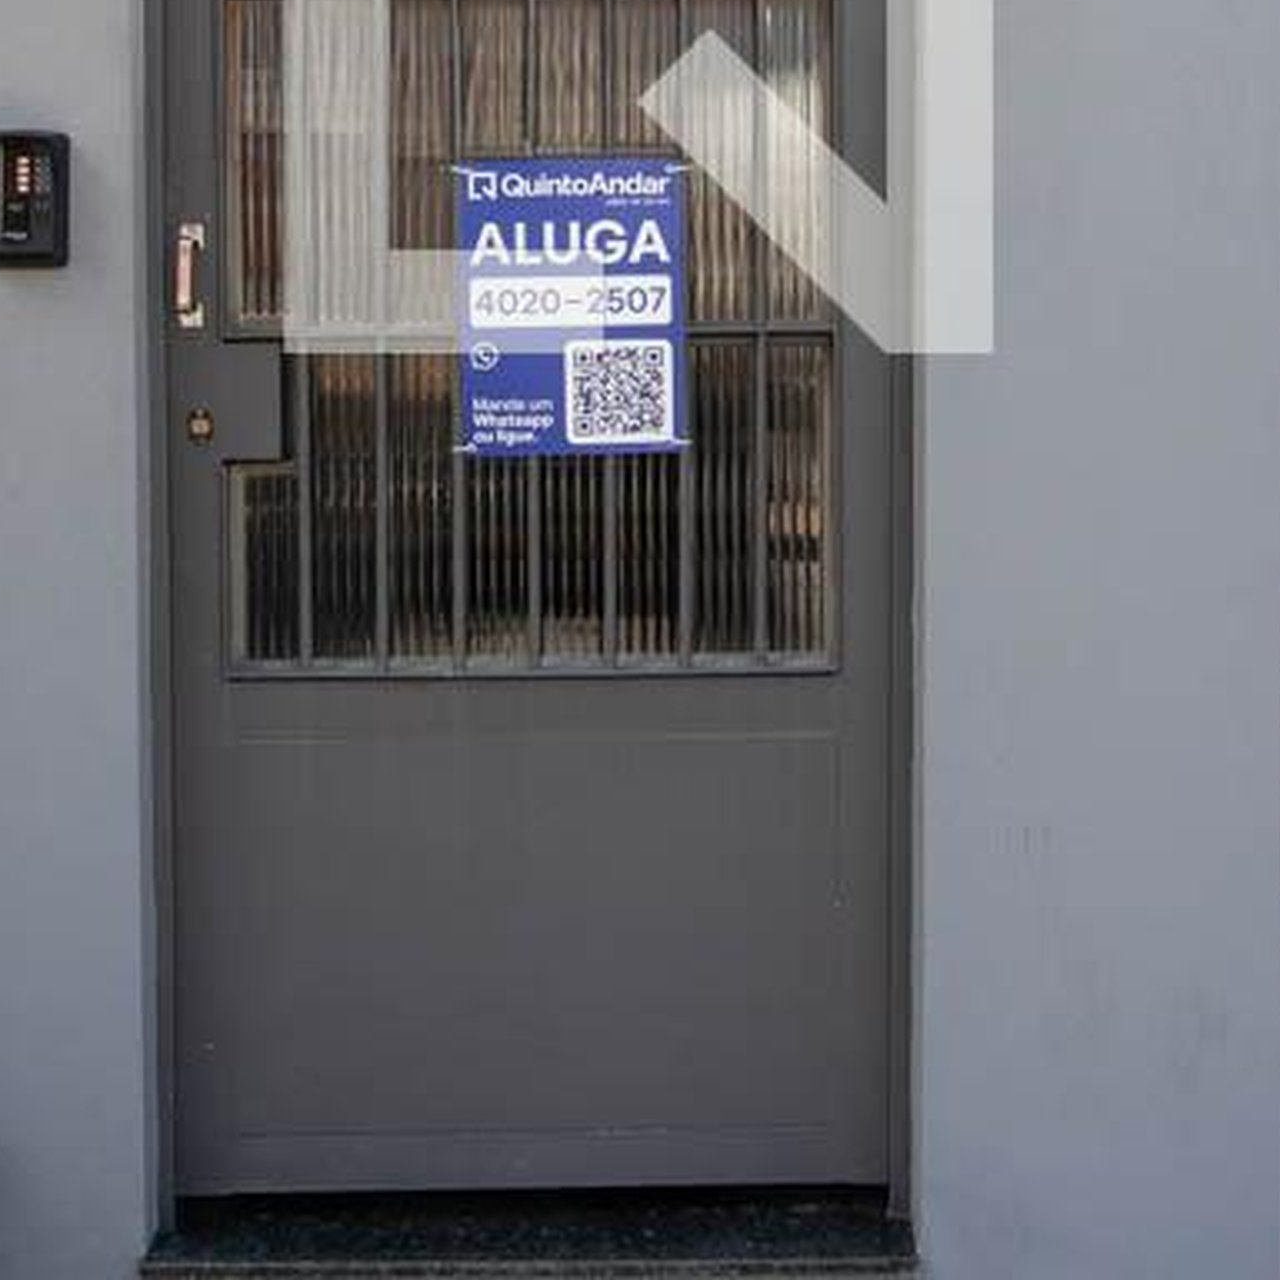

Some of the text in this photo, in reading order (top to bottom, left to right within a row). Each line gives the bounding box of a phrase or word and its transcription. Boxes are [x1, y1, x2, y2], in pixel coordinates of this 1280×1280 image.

[500, 172, 669, 198] QuintoAndar
[471, 220, 670, 266] ALUGA
[475, 285, 668, 316] 4020-2507
